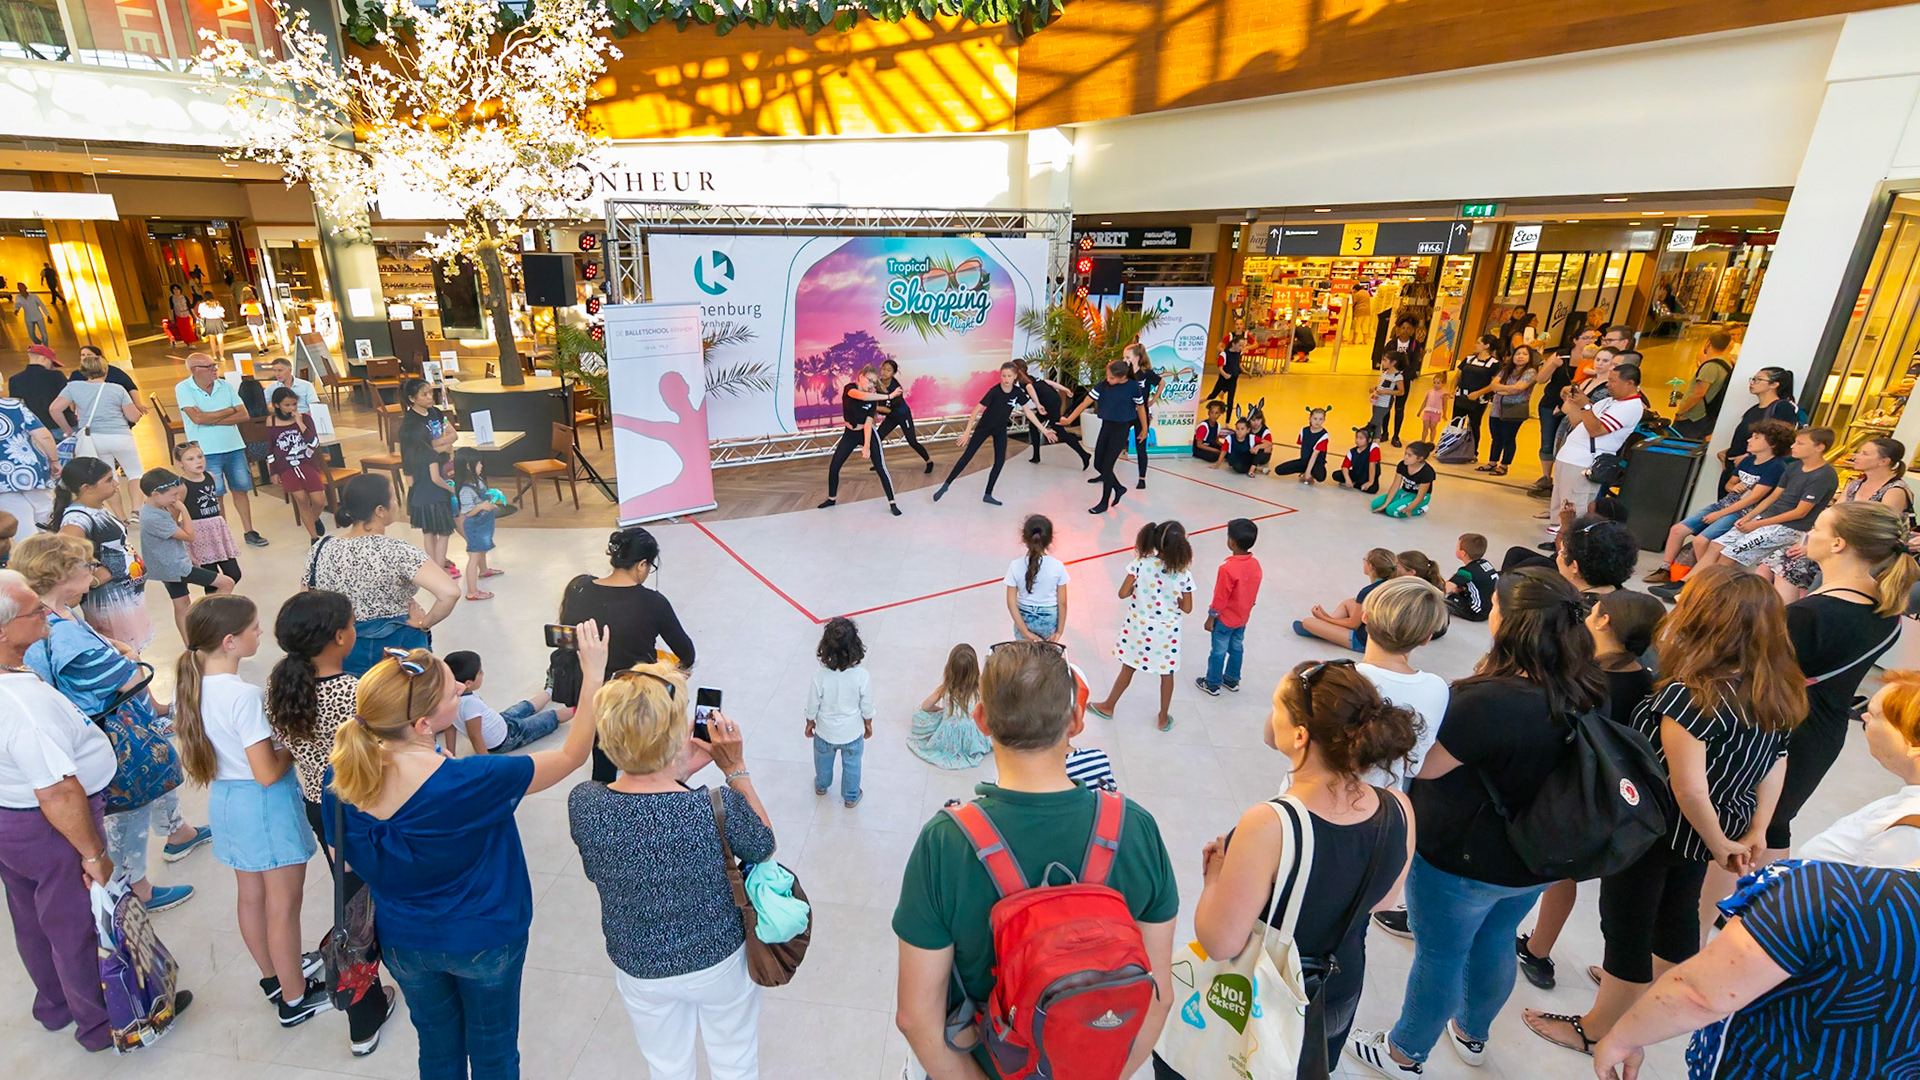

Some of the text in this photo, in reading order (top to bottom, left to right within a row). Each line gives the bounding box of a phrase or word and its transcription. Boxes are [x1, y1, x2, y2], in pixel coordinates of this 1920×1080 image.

[1353, 236, 1363, 251] 3
[1514, 229, 1538, 244] Etos
[1673, 233, 1693, 244] Etos
[889, 258, 930, 275] Tropical
[886, 277, 991, 324] Shopping
[1276, 291, 1291, 299] 1+1
[625, 327, 669, 337] BALLETSCHOOL
[949, 316, 975, 334] Night
[1220, 983, 1247, 1006] VOL
